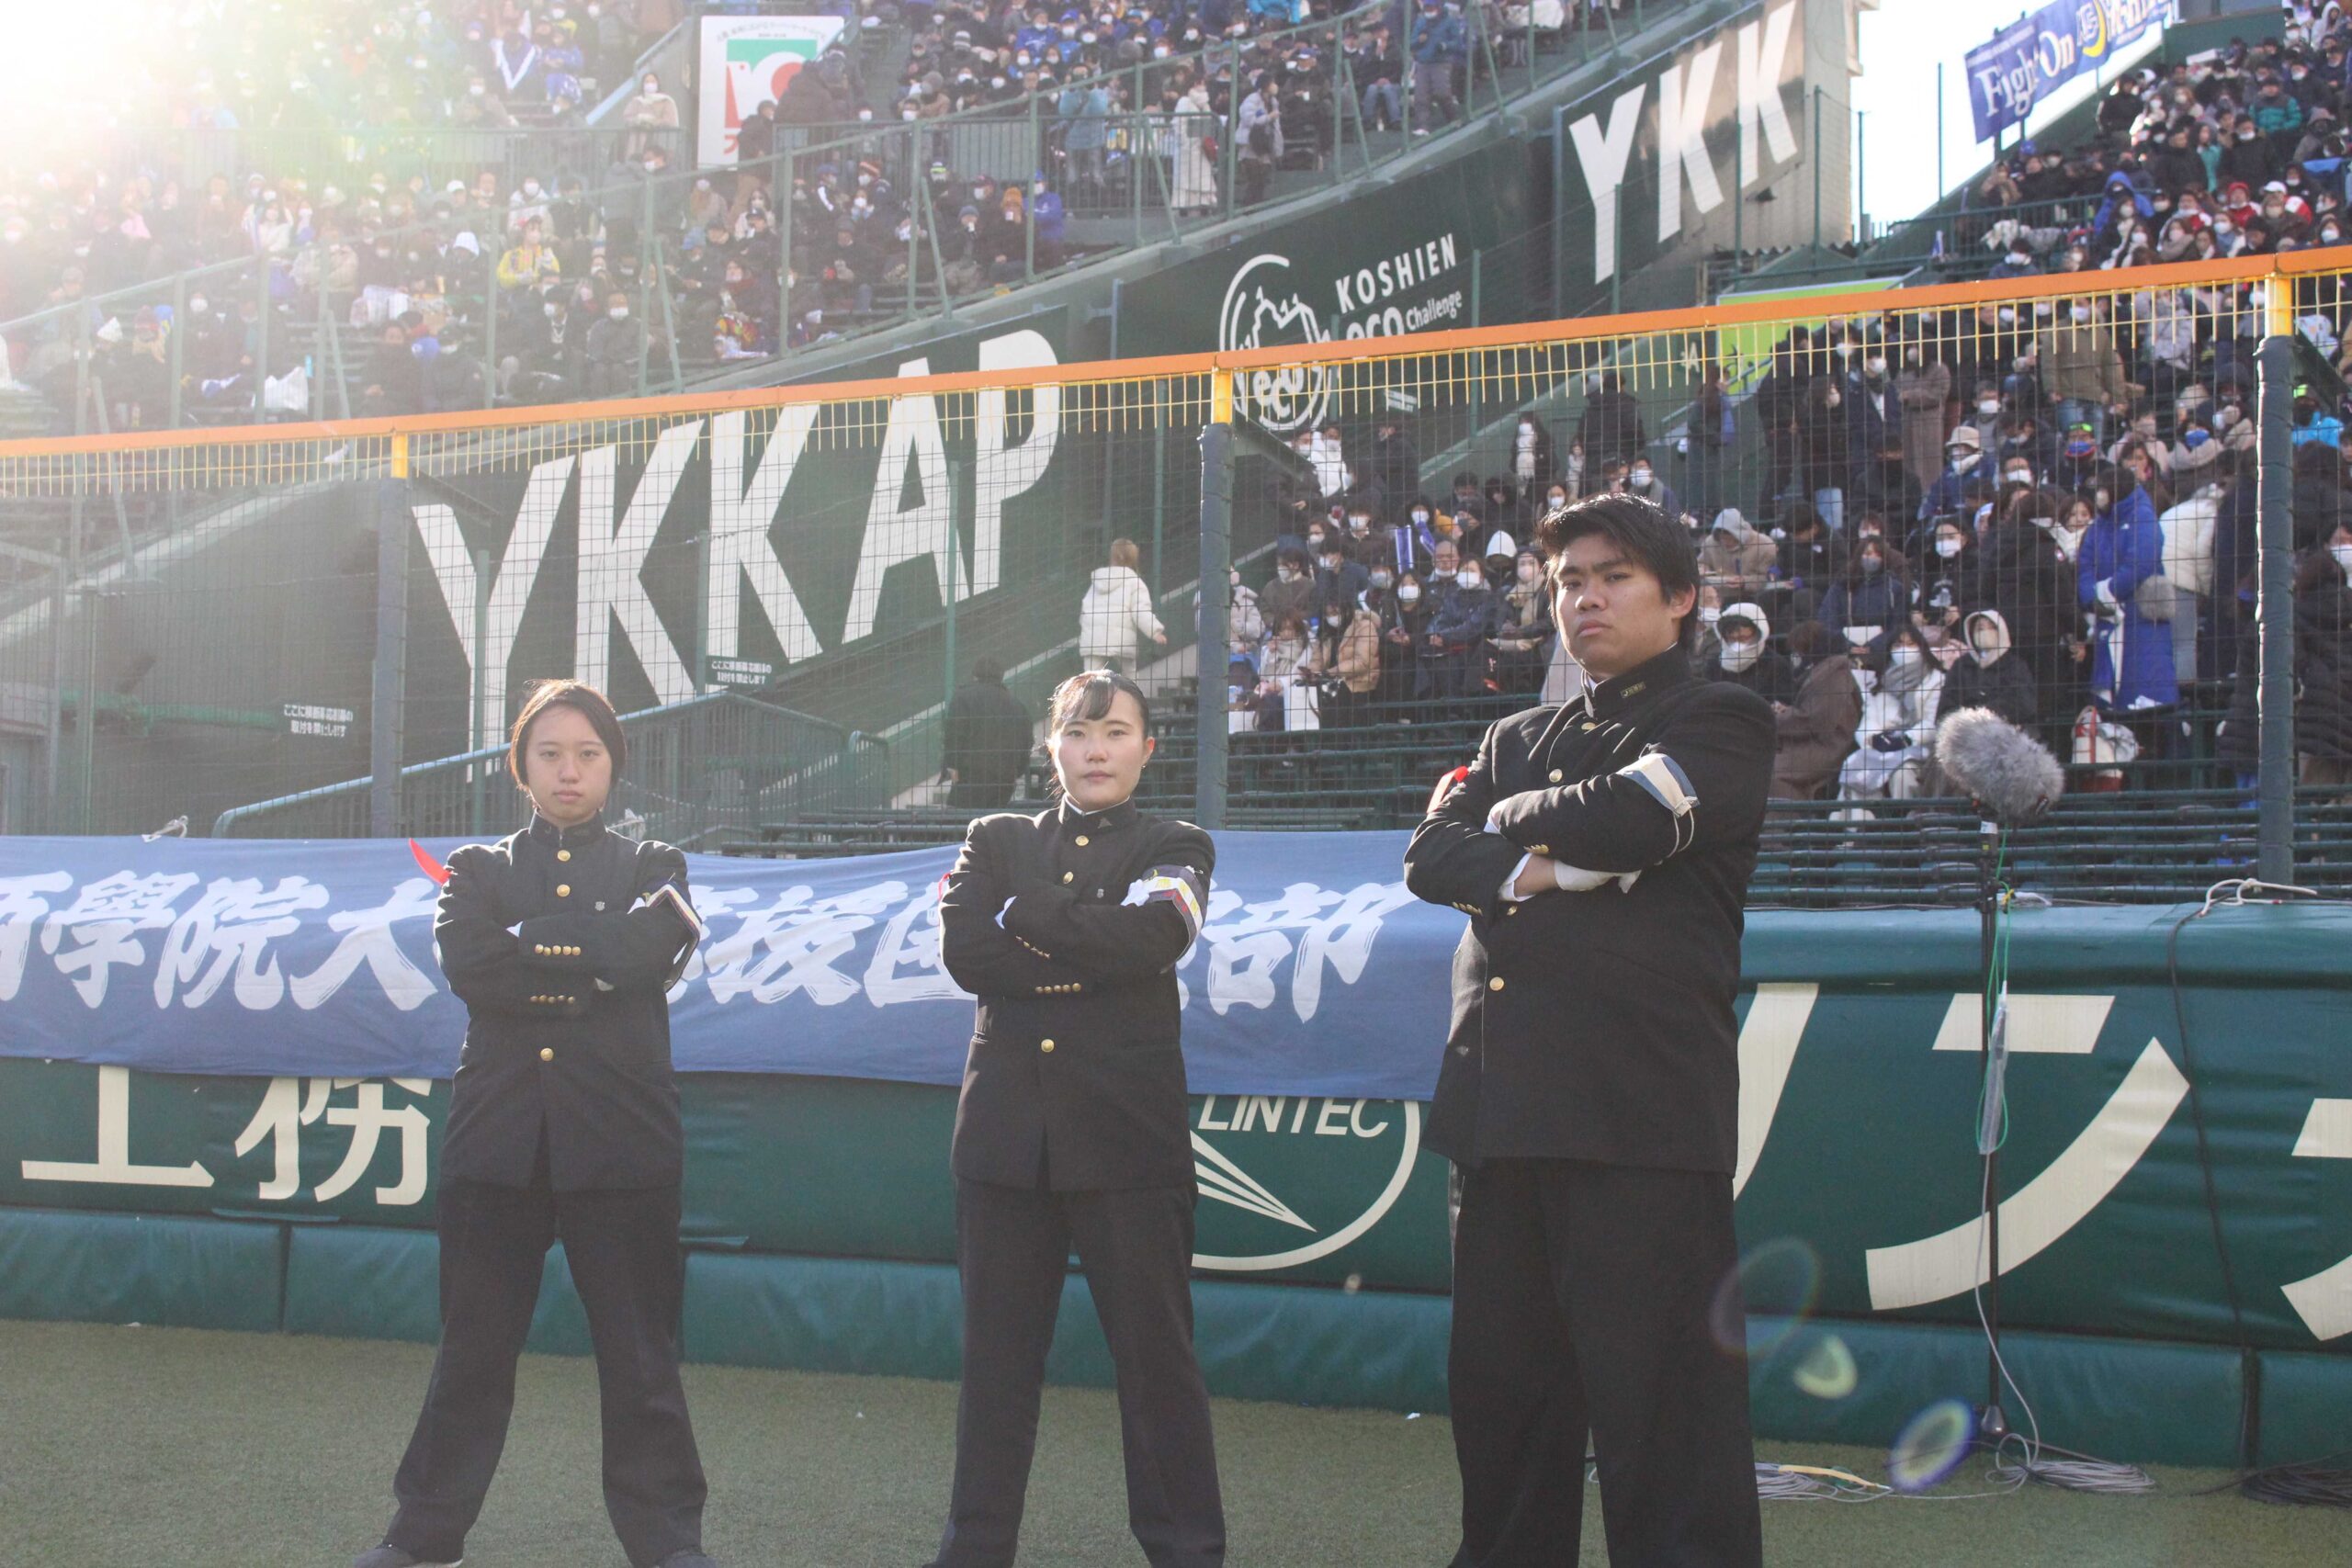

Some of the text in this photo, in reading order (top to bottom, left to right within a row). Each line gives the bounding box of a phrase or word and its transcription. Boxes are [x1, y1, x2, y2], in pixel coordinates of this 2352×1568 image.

[1568, 1, 1798, 286] YKK
[1336, 232, 1456, 314] KOSHIEN
[1406, 290, 1463, 331] Challenge
